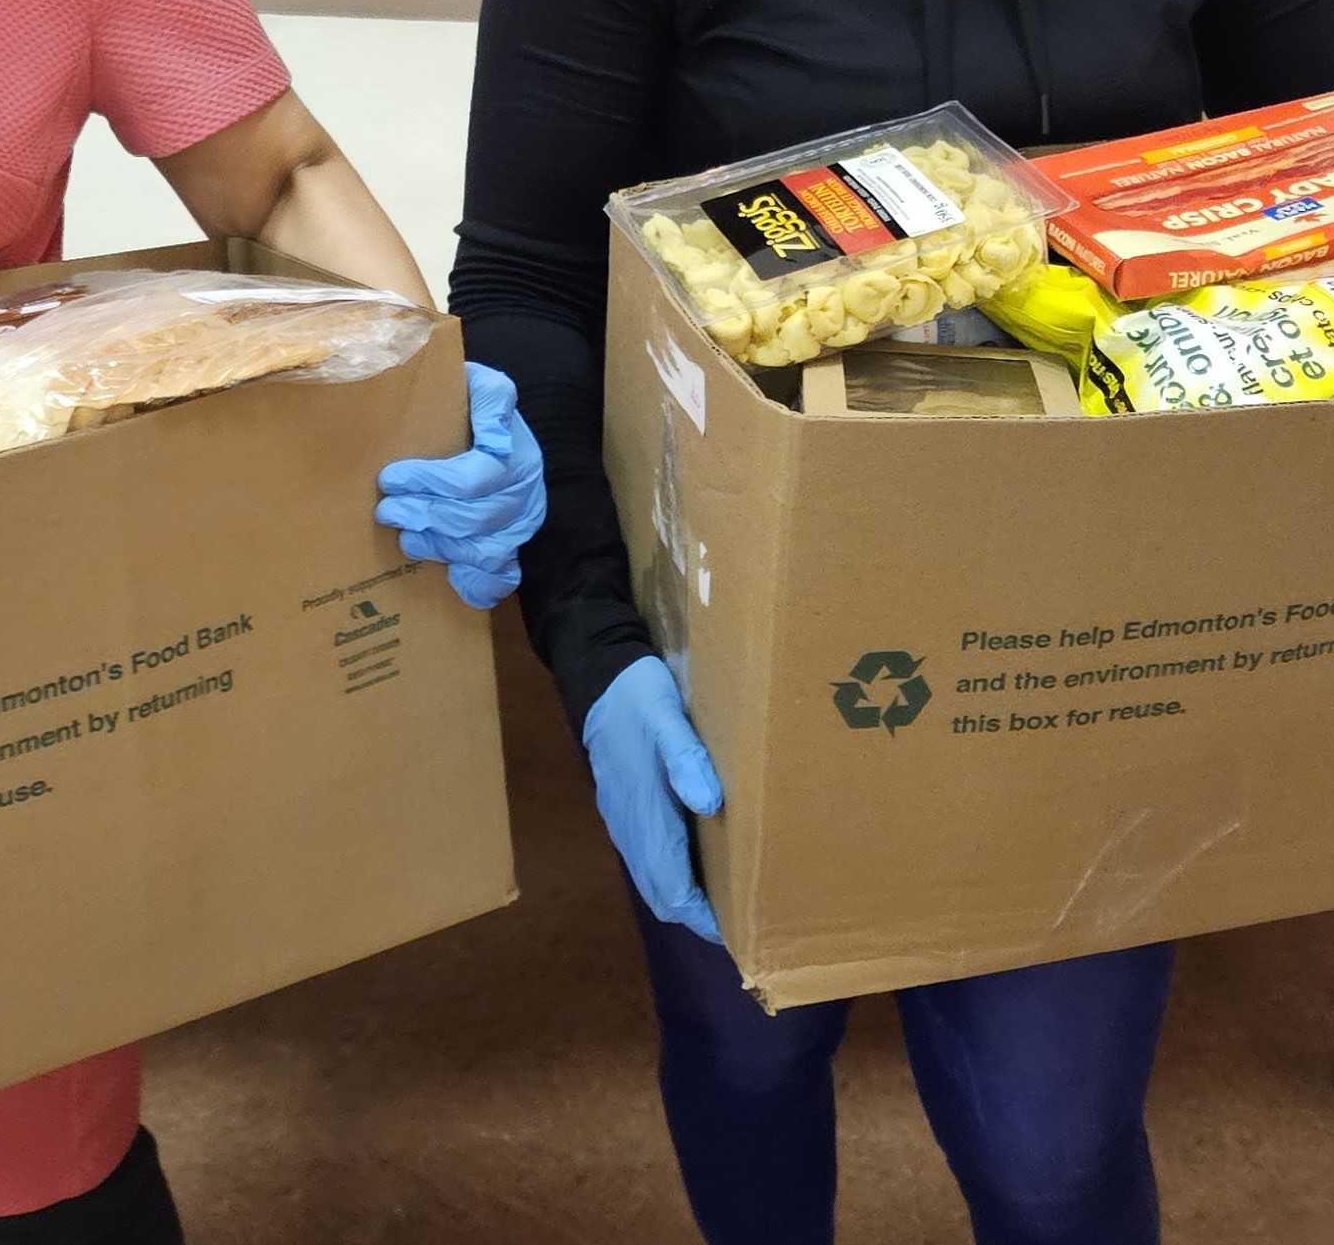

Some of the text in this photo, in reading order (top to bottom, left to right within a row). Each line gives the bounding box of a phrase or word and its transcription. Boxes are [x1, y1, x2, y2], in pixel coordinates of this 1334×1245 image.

[1186, 146, 1253, 171] BACON
[808, 182, 864, 233] TORTELLINI
[1162, 196, 1263, 230] CRISP
[1261, 238, 1332, 271] BACON
[1268, 289, 1314, 306] cps
[1289, 346, 1326, 379] et
[131, 635, 189, 674] Food
[196, 613, 254, 650] Bank
[961, 630, 1051, 651] Please
[1059, 625, 1115, 648] help
[1123, 608, 1277, 640] Edmonton's
[955, 672, 1006, 694] and
[1014, 670, 1057, 690] the
[1064, 653, 1226, 689] environment
[1233, 650, 1264, 672] by
[88, 709, 120, 733] by
[128, 669, 234, 723] returning
[951, 699, 1186, 734] this box for reuse.
